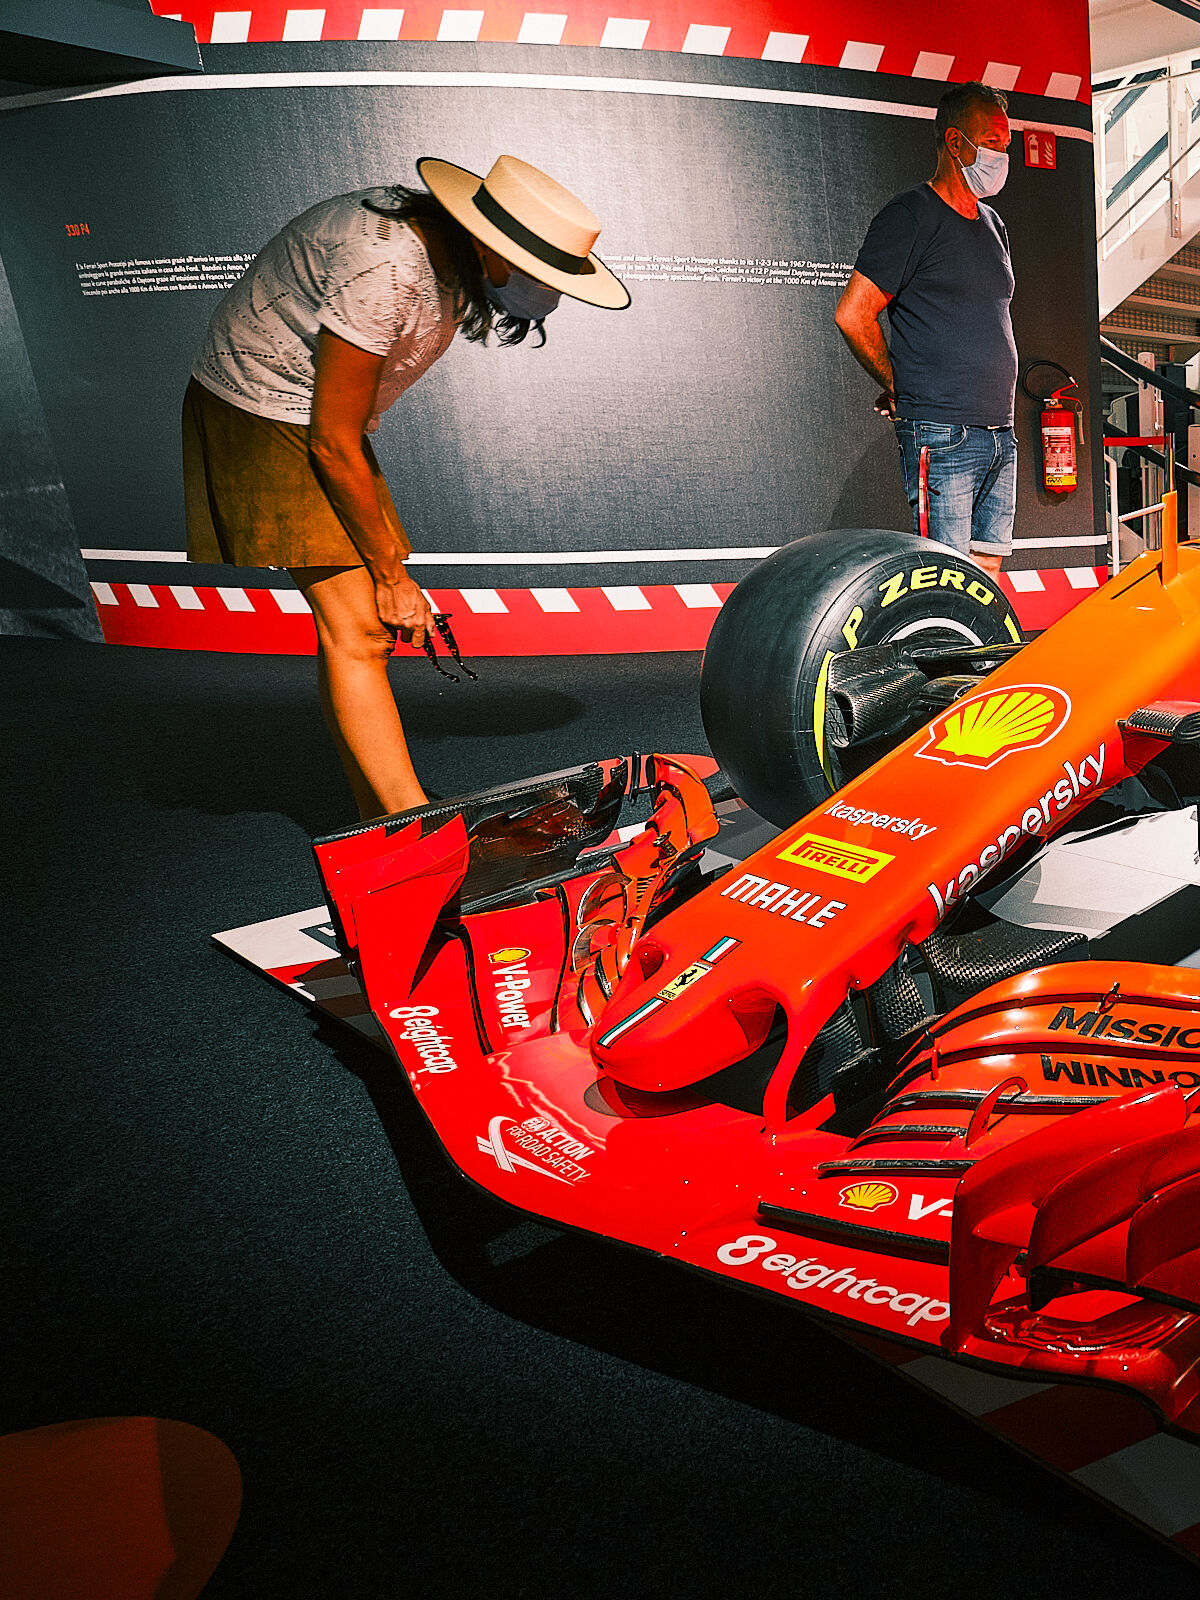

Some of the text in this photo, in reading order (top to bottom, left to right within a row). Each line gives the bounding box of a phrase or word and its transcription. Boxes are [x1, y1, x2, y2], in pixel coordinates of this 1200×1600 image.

[842, 565, 994, 650] P ZERO
[824, 799, 939, 841] kaspersky
[927, 743, 1106, 920] kaspersky
[791, 840, 879, 875] PIRELLI
[720, 872, 846, 929] MAHLE
[492, 962, 532, 1028] V-Power
[506, 1126, 592, 1181] FOR ROAD SAFETY
[536, 1127, 595, 1161] ACTION
